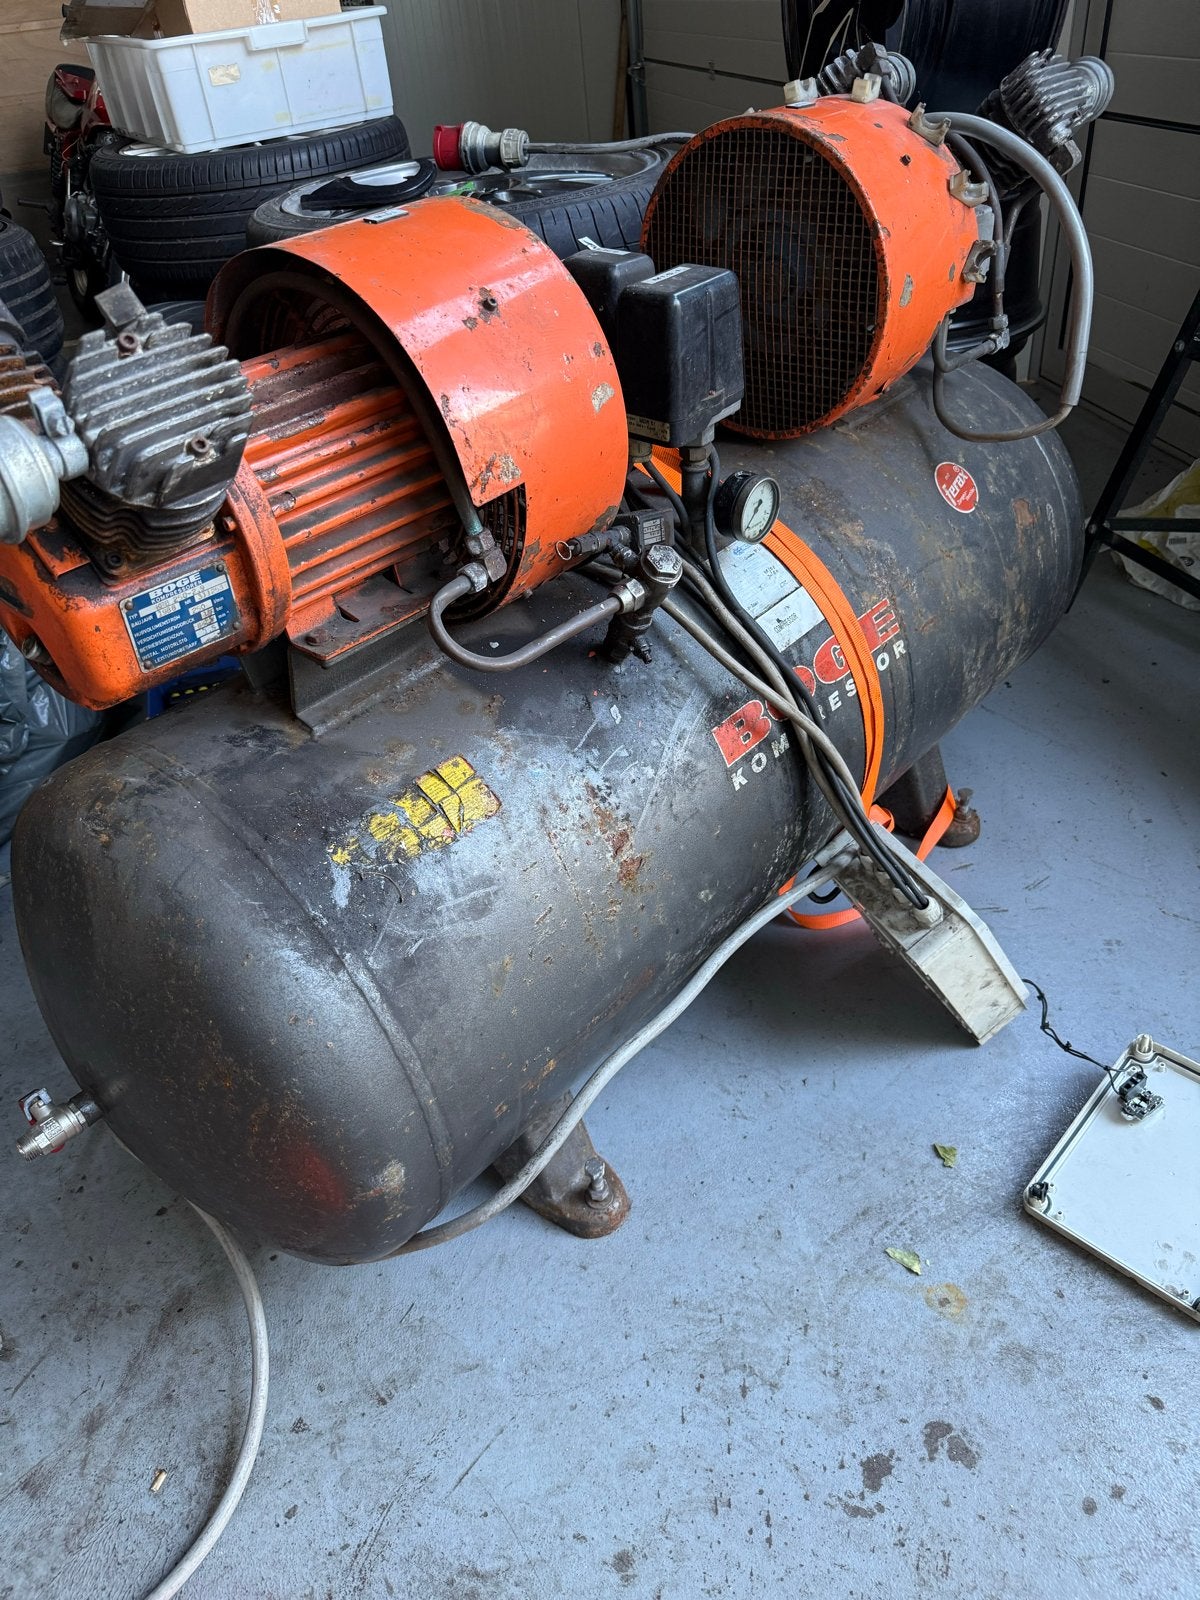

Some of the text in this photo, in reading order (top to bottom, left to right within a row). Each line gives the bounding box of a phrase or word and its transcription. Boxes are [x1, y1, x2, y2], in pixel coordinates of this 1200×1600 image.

[942, 470, 968, 506] ferax
[149, 572, 201, 600] BOGE
[151, 580, 202, 604] KOMPRESSOREN
[130, 615, 154, 628] BAUJAHR
